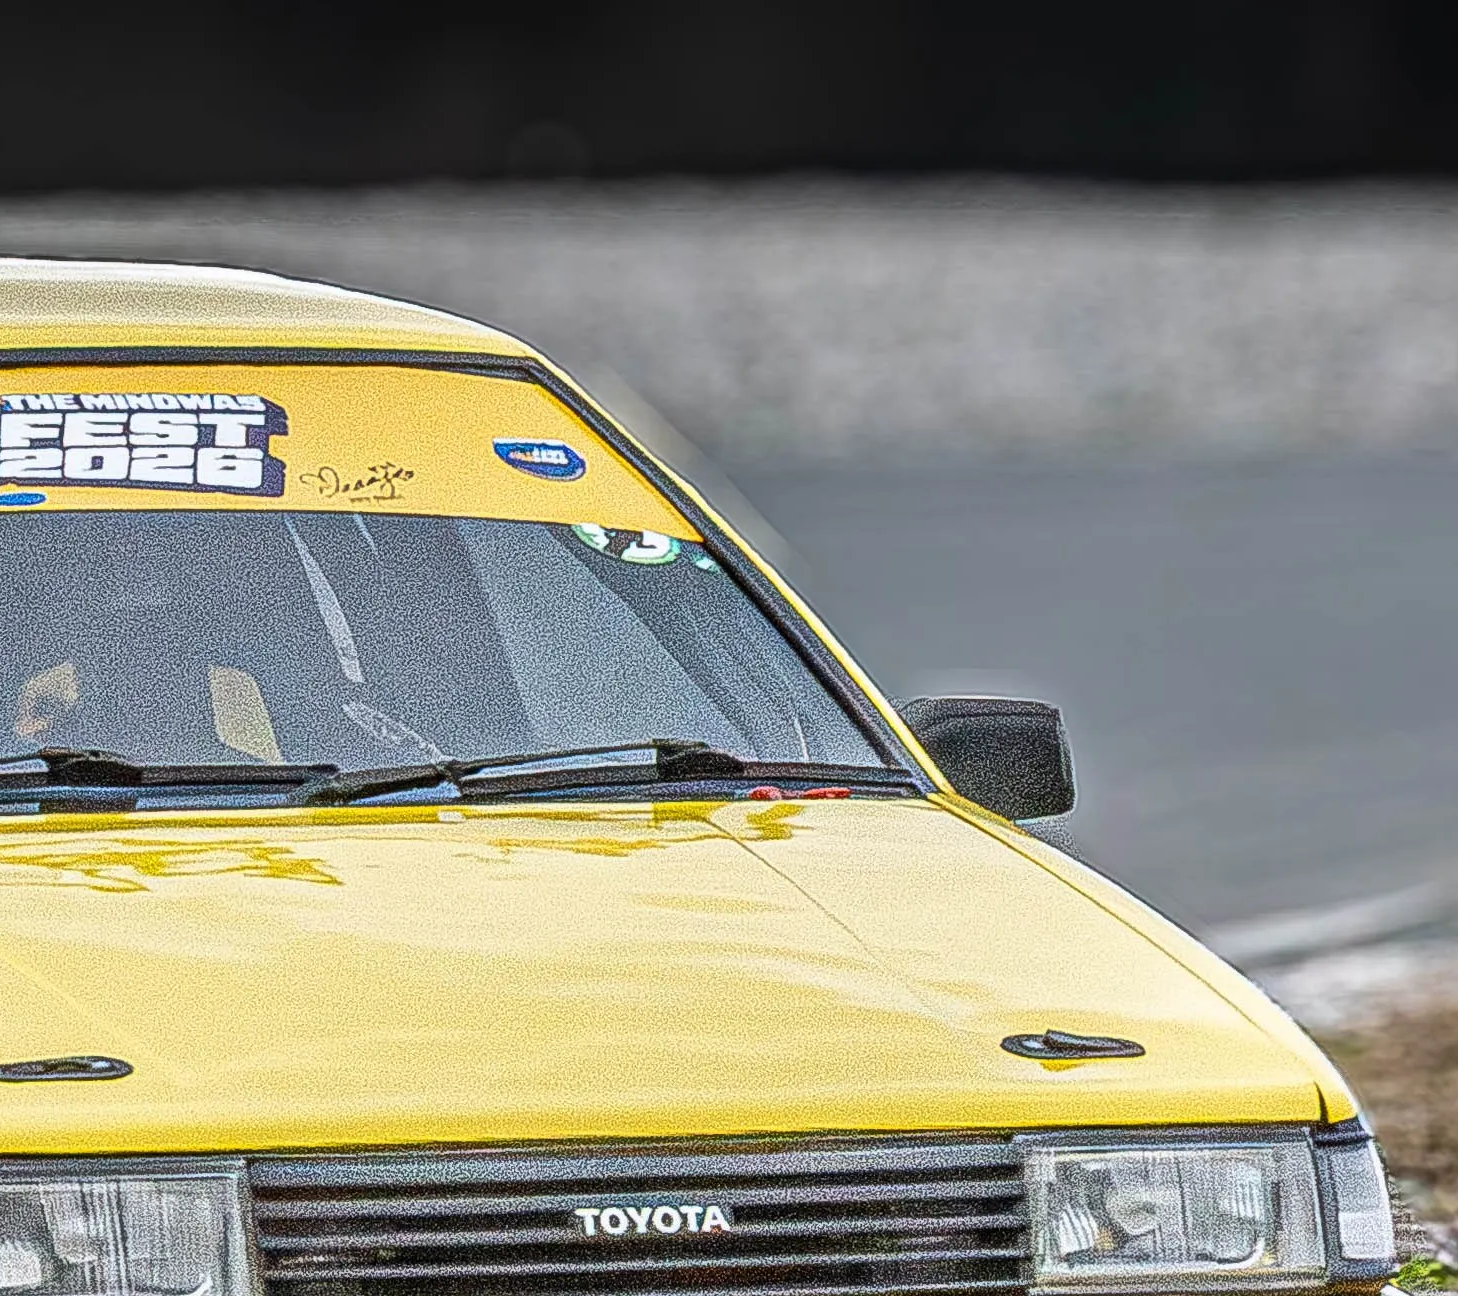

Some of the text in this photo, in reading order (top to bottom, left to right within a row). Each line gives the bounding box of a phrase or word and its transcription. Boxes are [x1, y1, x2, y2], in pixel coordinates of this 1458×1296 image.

[0, 393, 82, 410] THE
[0, 411, 267, 448] FEST
[575, 1205, 731, 1236] TOYOTA
